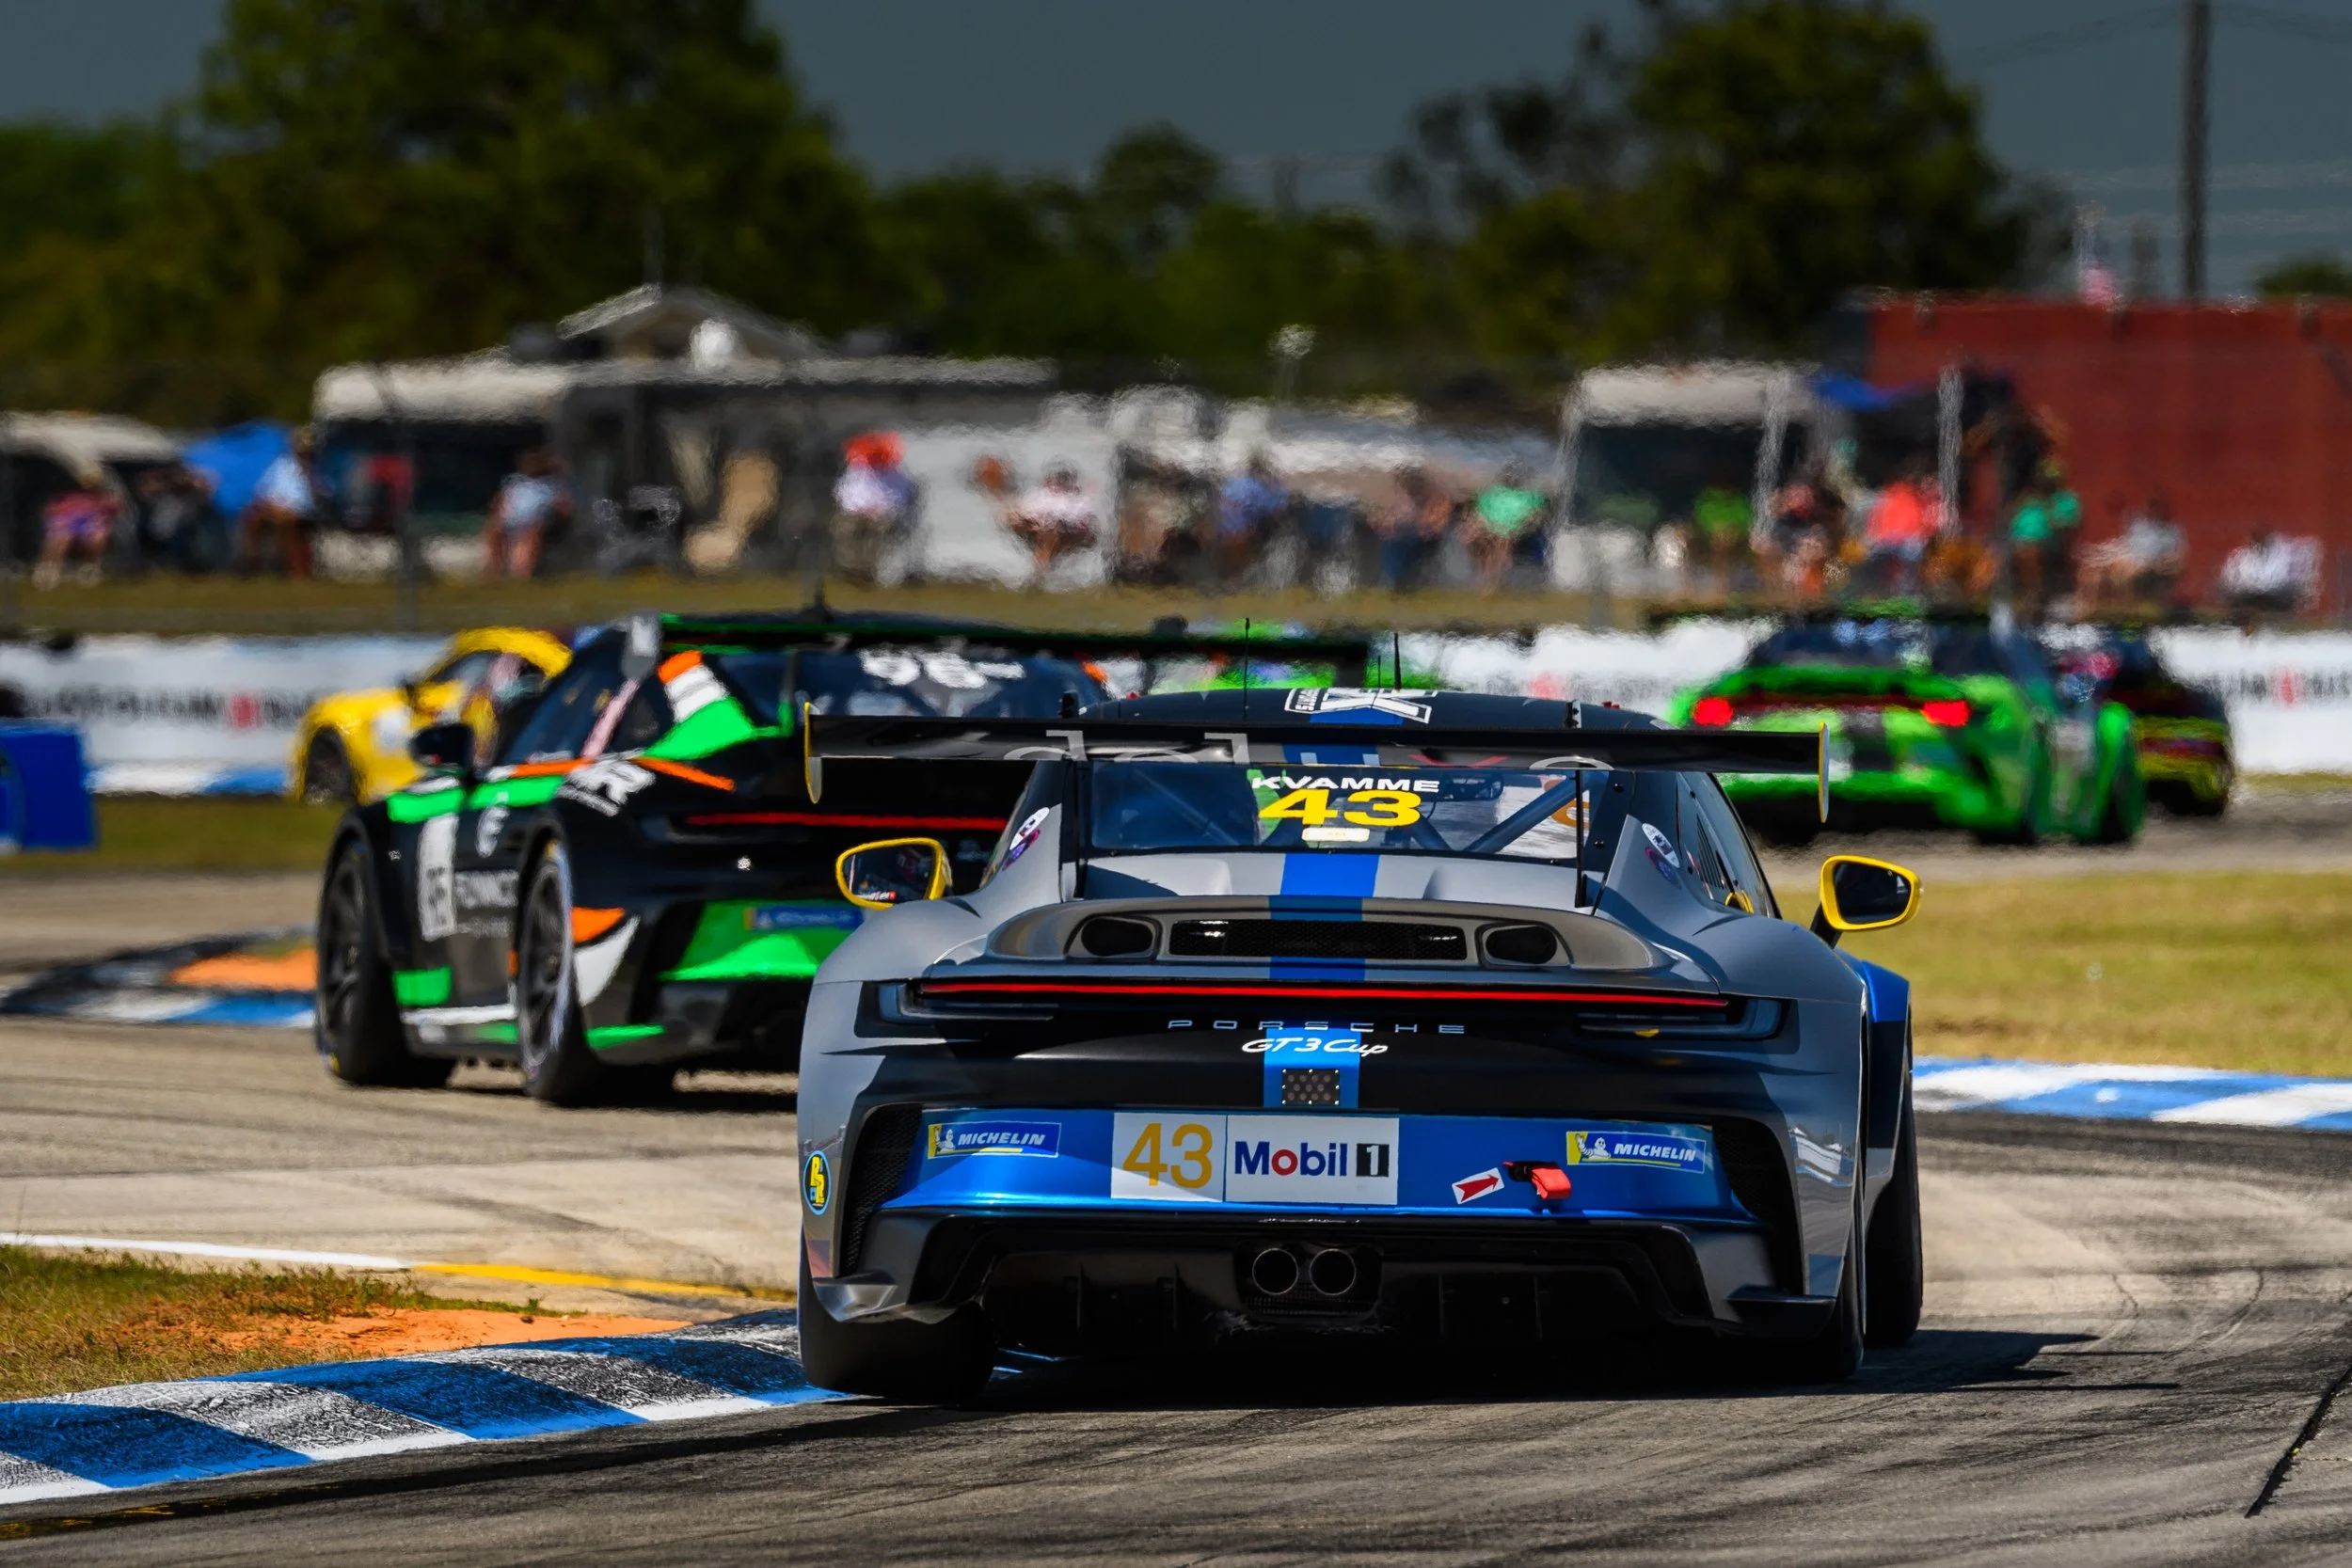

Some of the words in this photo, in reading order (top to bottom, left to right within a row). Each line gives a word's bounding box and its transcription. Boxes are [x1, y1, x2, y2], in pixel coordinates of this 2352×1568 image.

[1251, 776, 1439, 793] KVAMME
[1258, 788, 1422, 827] 43
[1168, 1020, 1465, 1034] PORSCHE
[958, 1132, 1045, 1146] MICHELIN
[1122, 1122, 1214, 1189] 43
[1234, 1141, 1348, 1177] Mobil
[1362, 1144, 1384, 1177] 1
[1613, 1142, 1696, 1162] MICHELIN
